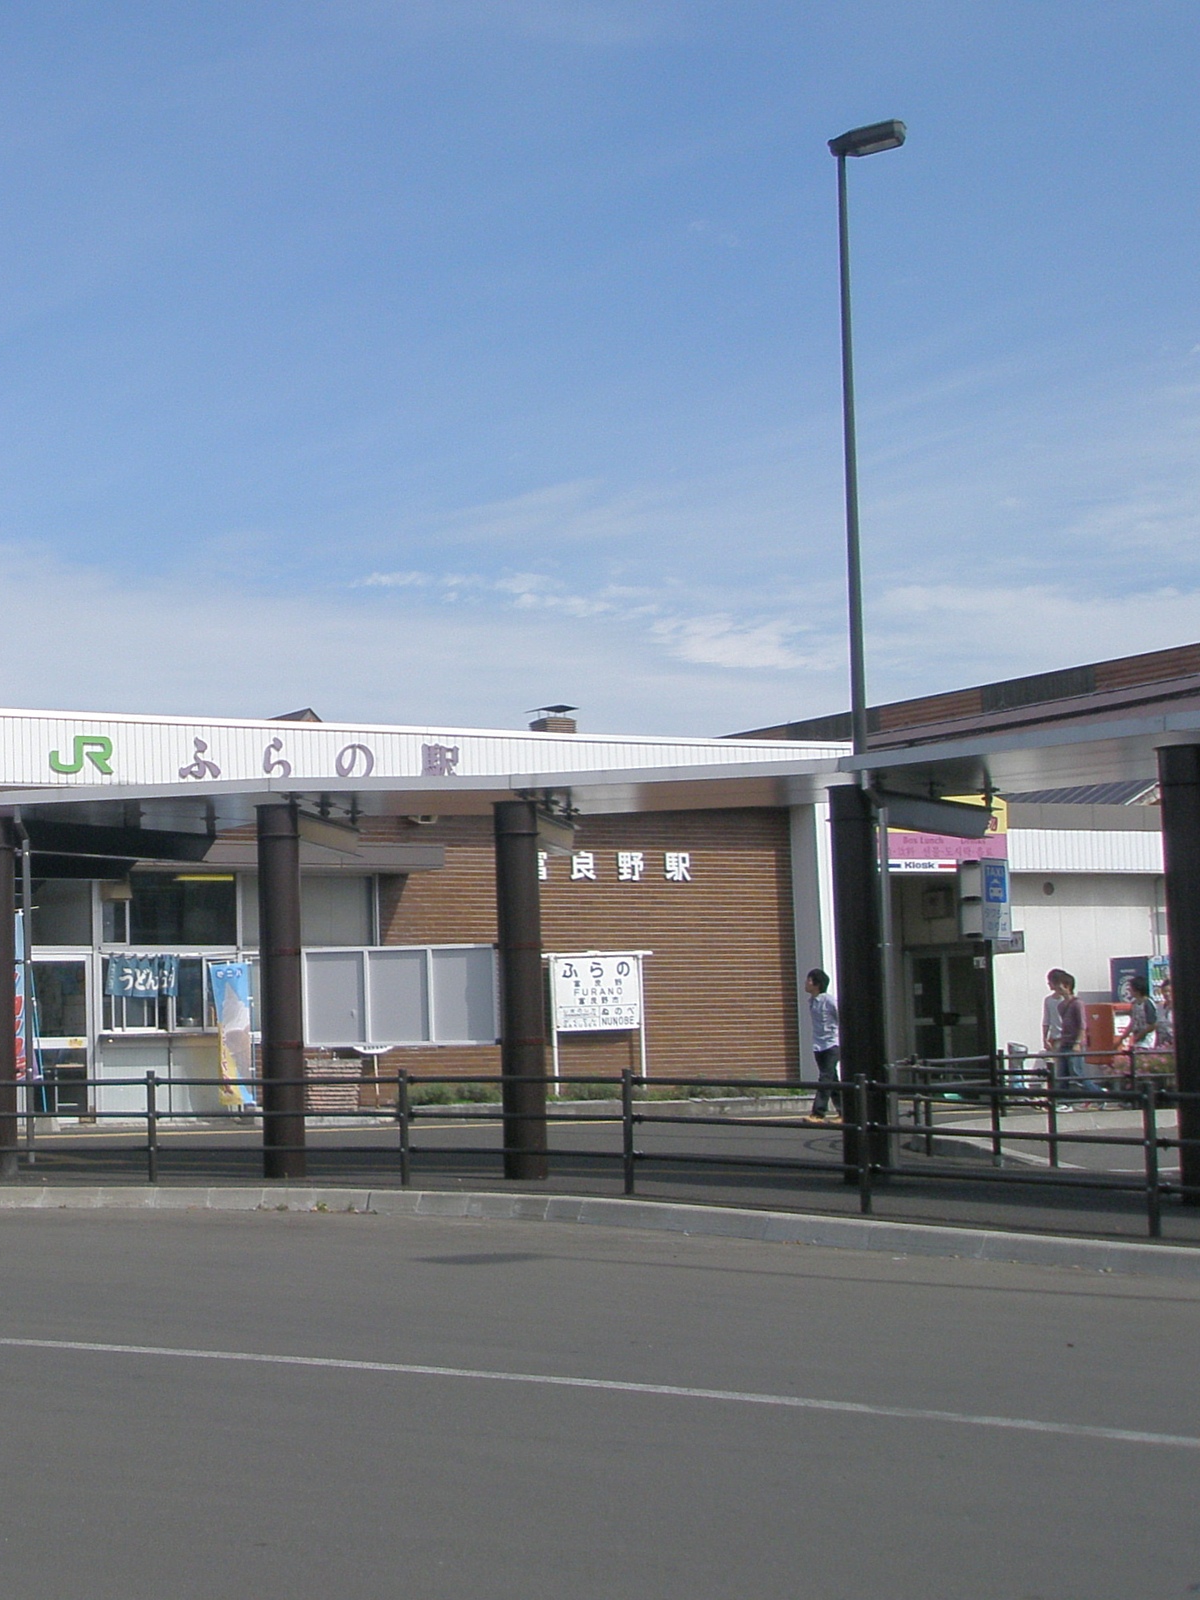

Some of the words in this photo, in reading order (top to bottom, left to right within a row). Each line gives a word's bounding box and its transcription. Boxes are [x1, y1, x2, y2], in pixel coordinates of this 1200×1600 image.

[49, 735, 115, 775] JR
[179, 737, 460, 779] ふらの駅
[986, 866, 1004, 876] TAXI
[562, 961, 630, 978] ふらの
[574, 987, 622, 996] FURANO
[602, 1016, 634, 1026] NUNOBE
